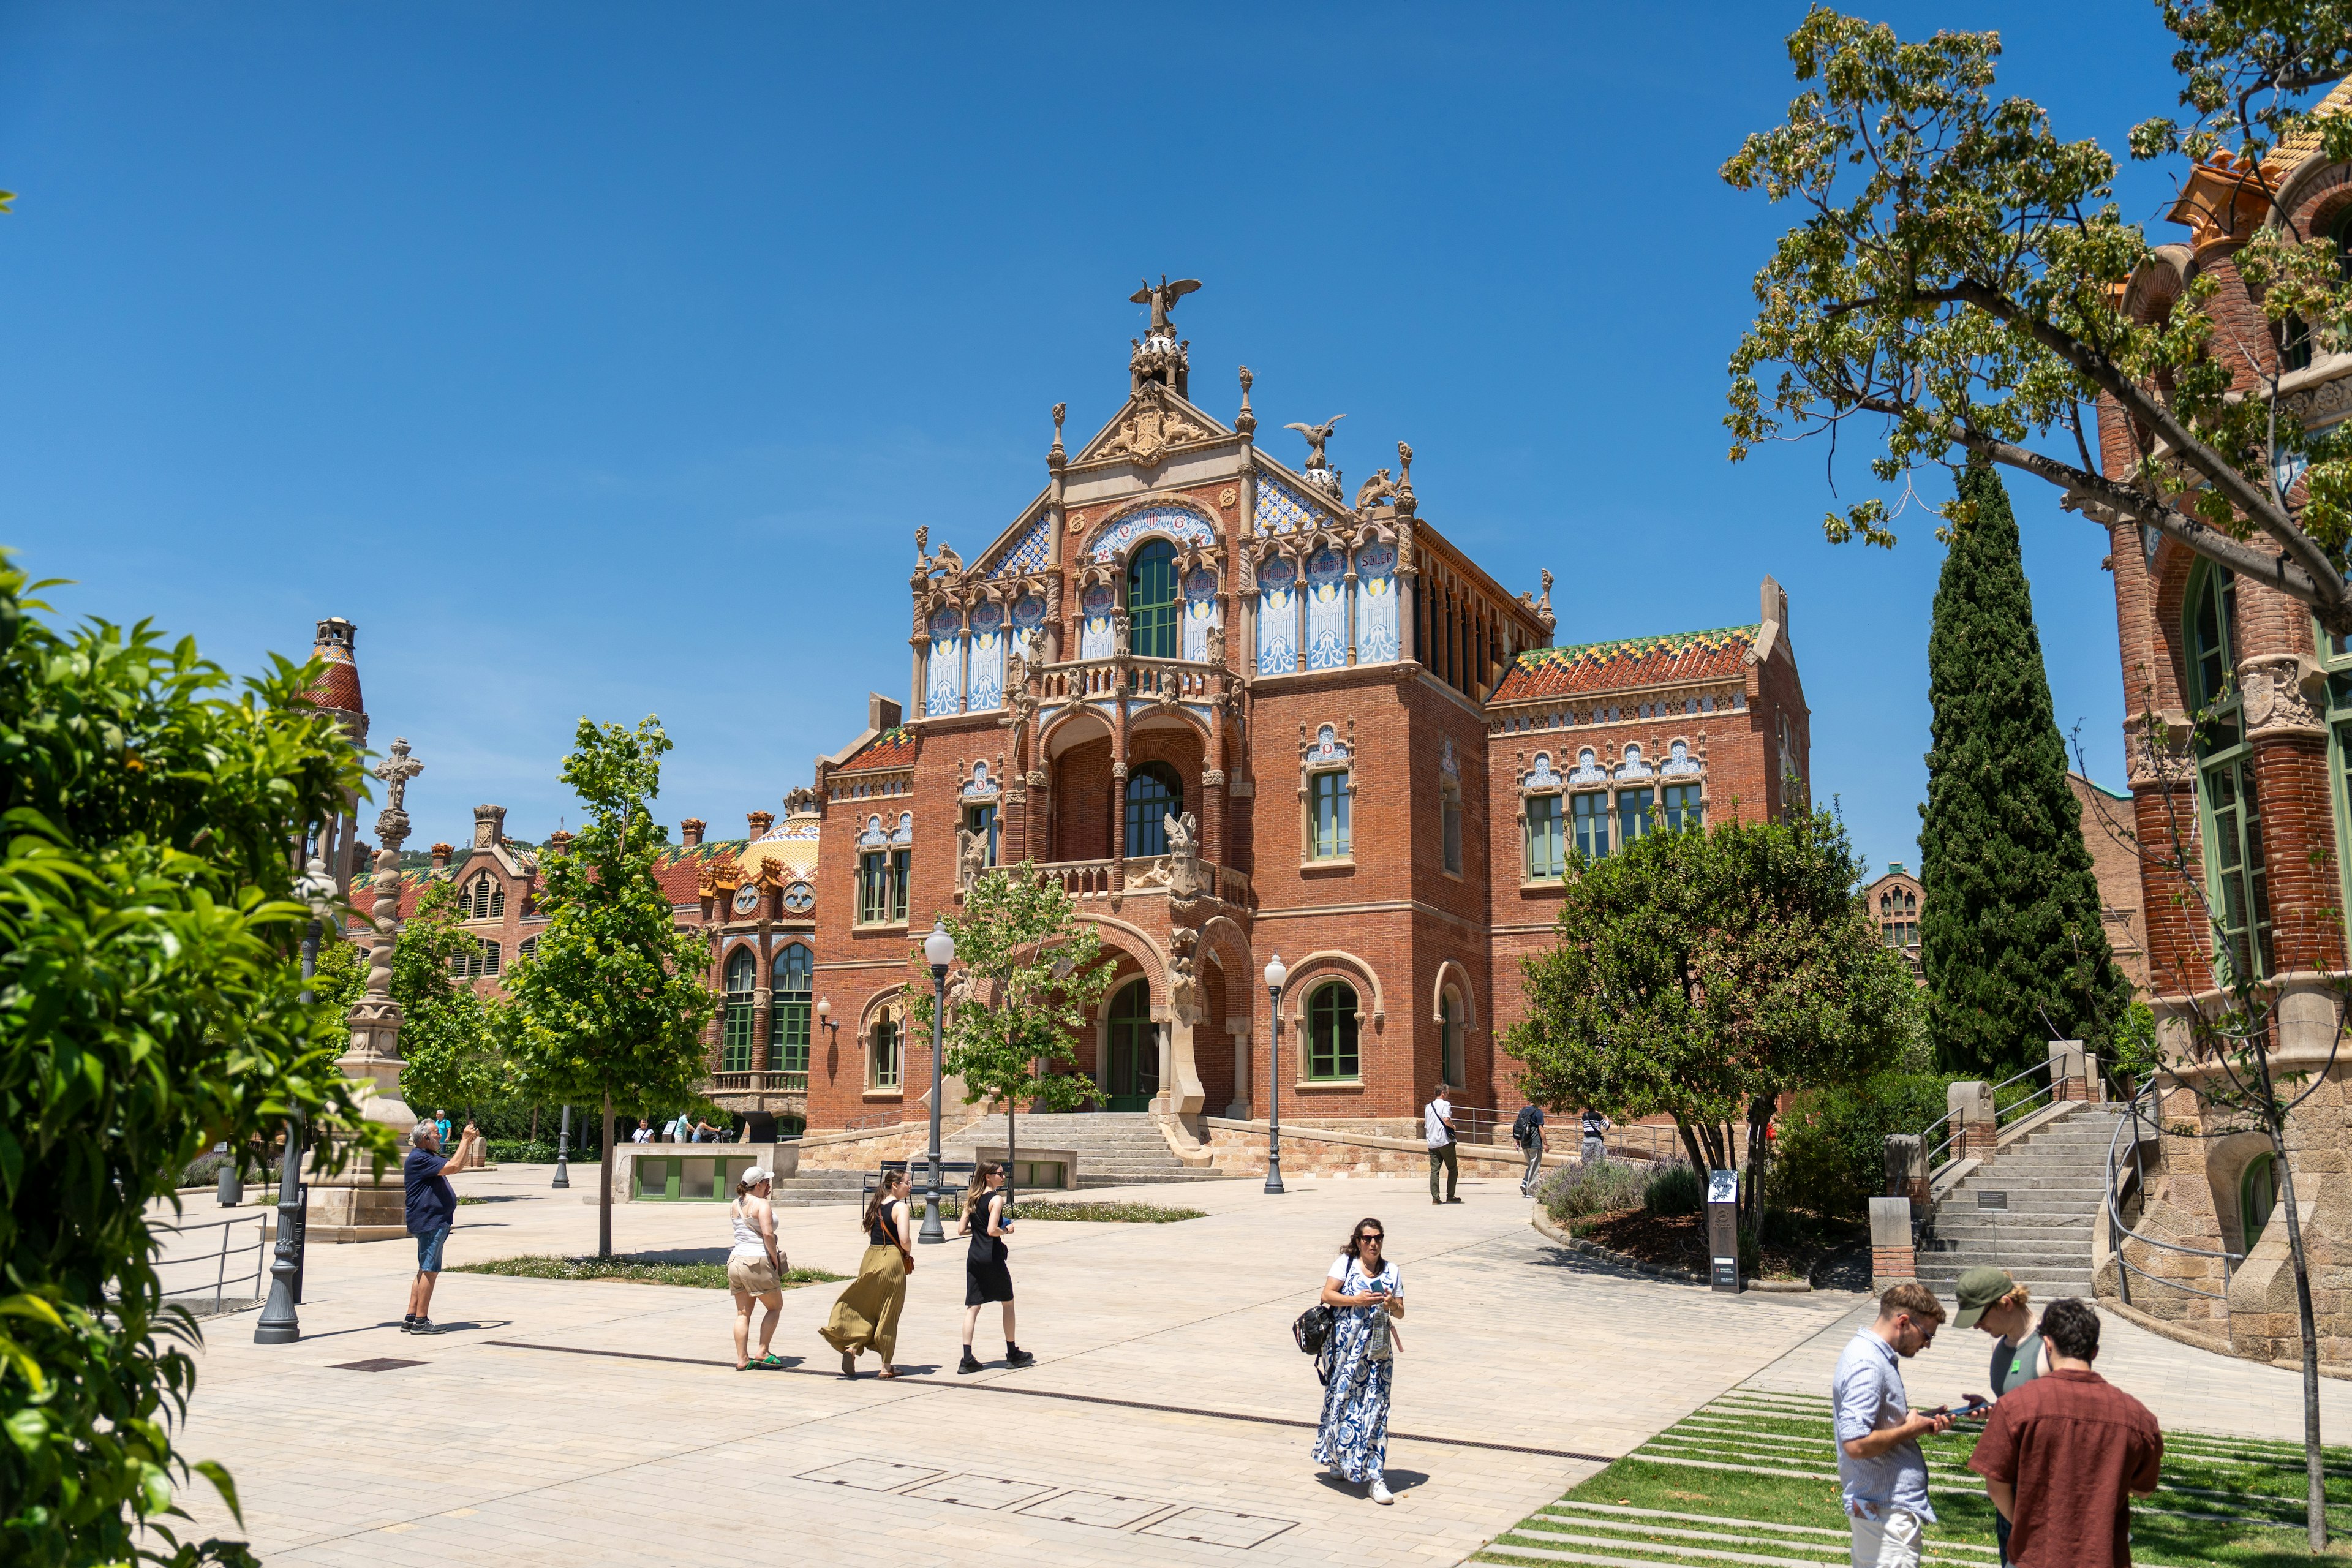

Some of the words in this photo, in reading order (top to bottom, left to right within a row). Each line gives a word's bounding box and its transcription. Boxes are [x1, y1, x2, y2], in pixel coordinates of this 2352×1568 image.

[1308, 559, 1344, 573] TORRENT
[1362, 552, 1392, 567] SOLER
[1258, 565, 1297, 581] MARSILLACH
[1083, 592, 1114, 606] GIMBERNAT
[971, 609, 1003, 623] MENDOZA
